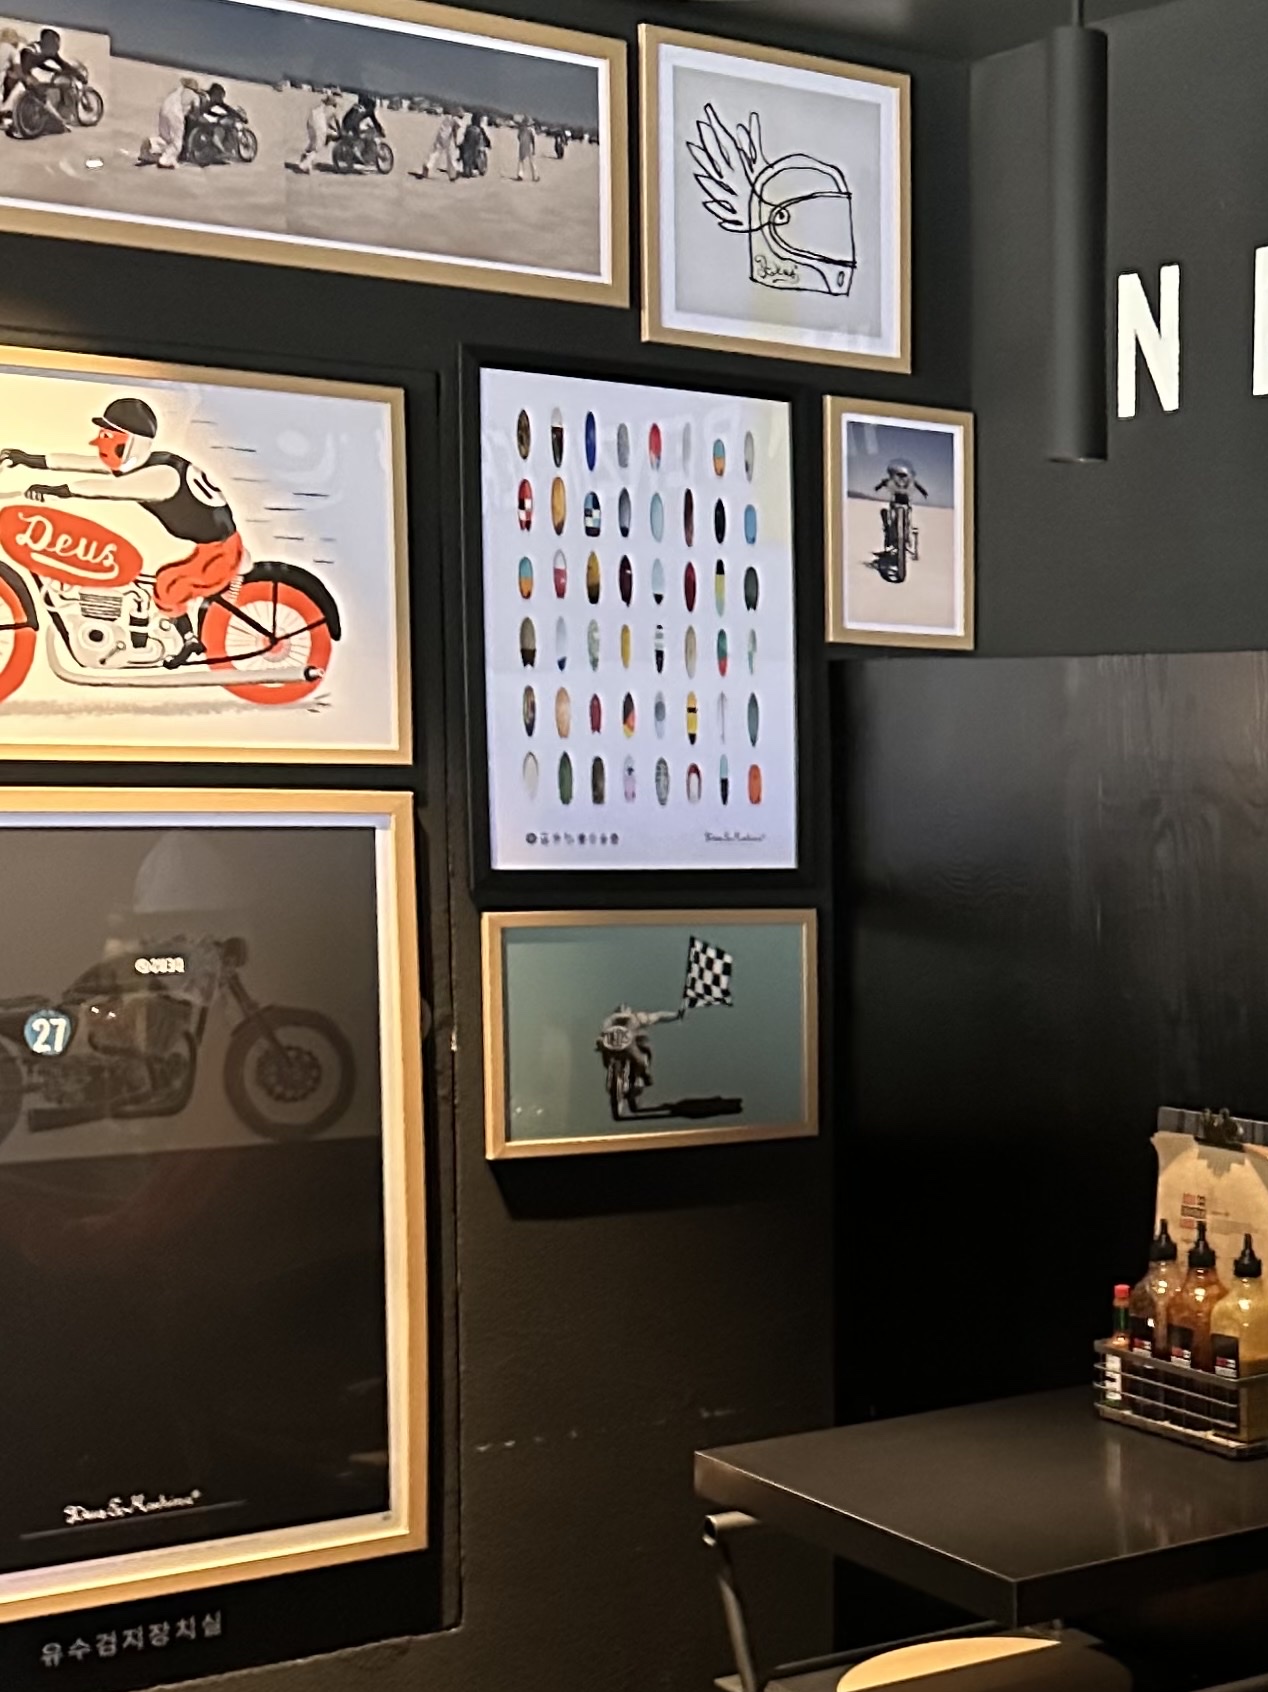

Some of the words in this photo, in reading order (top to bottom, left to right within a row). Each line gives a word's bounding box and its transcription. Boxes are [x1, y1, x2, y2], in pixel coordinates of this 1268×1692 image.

[15, 511, 118, 569] Deus
[32, 1018, 66, 1053] 27
[40, 1610, 222, 1668] 유수검지장치실
